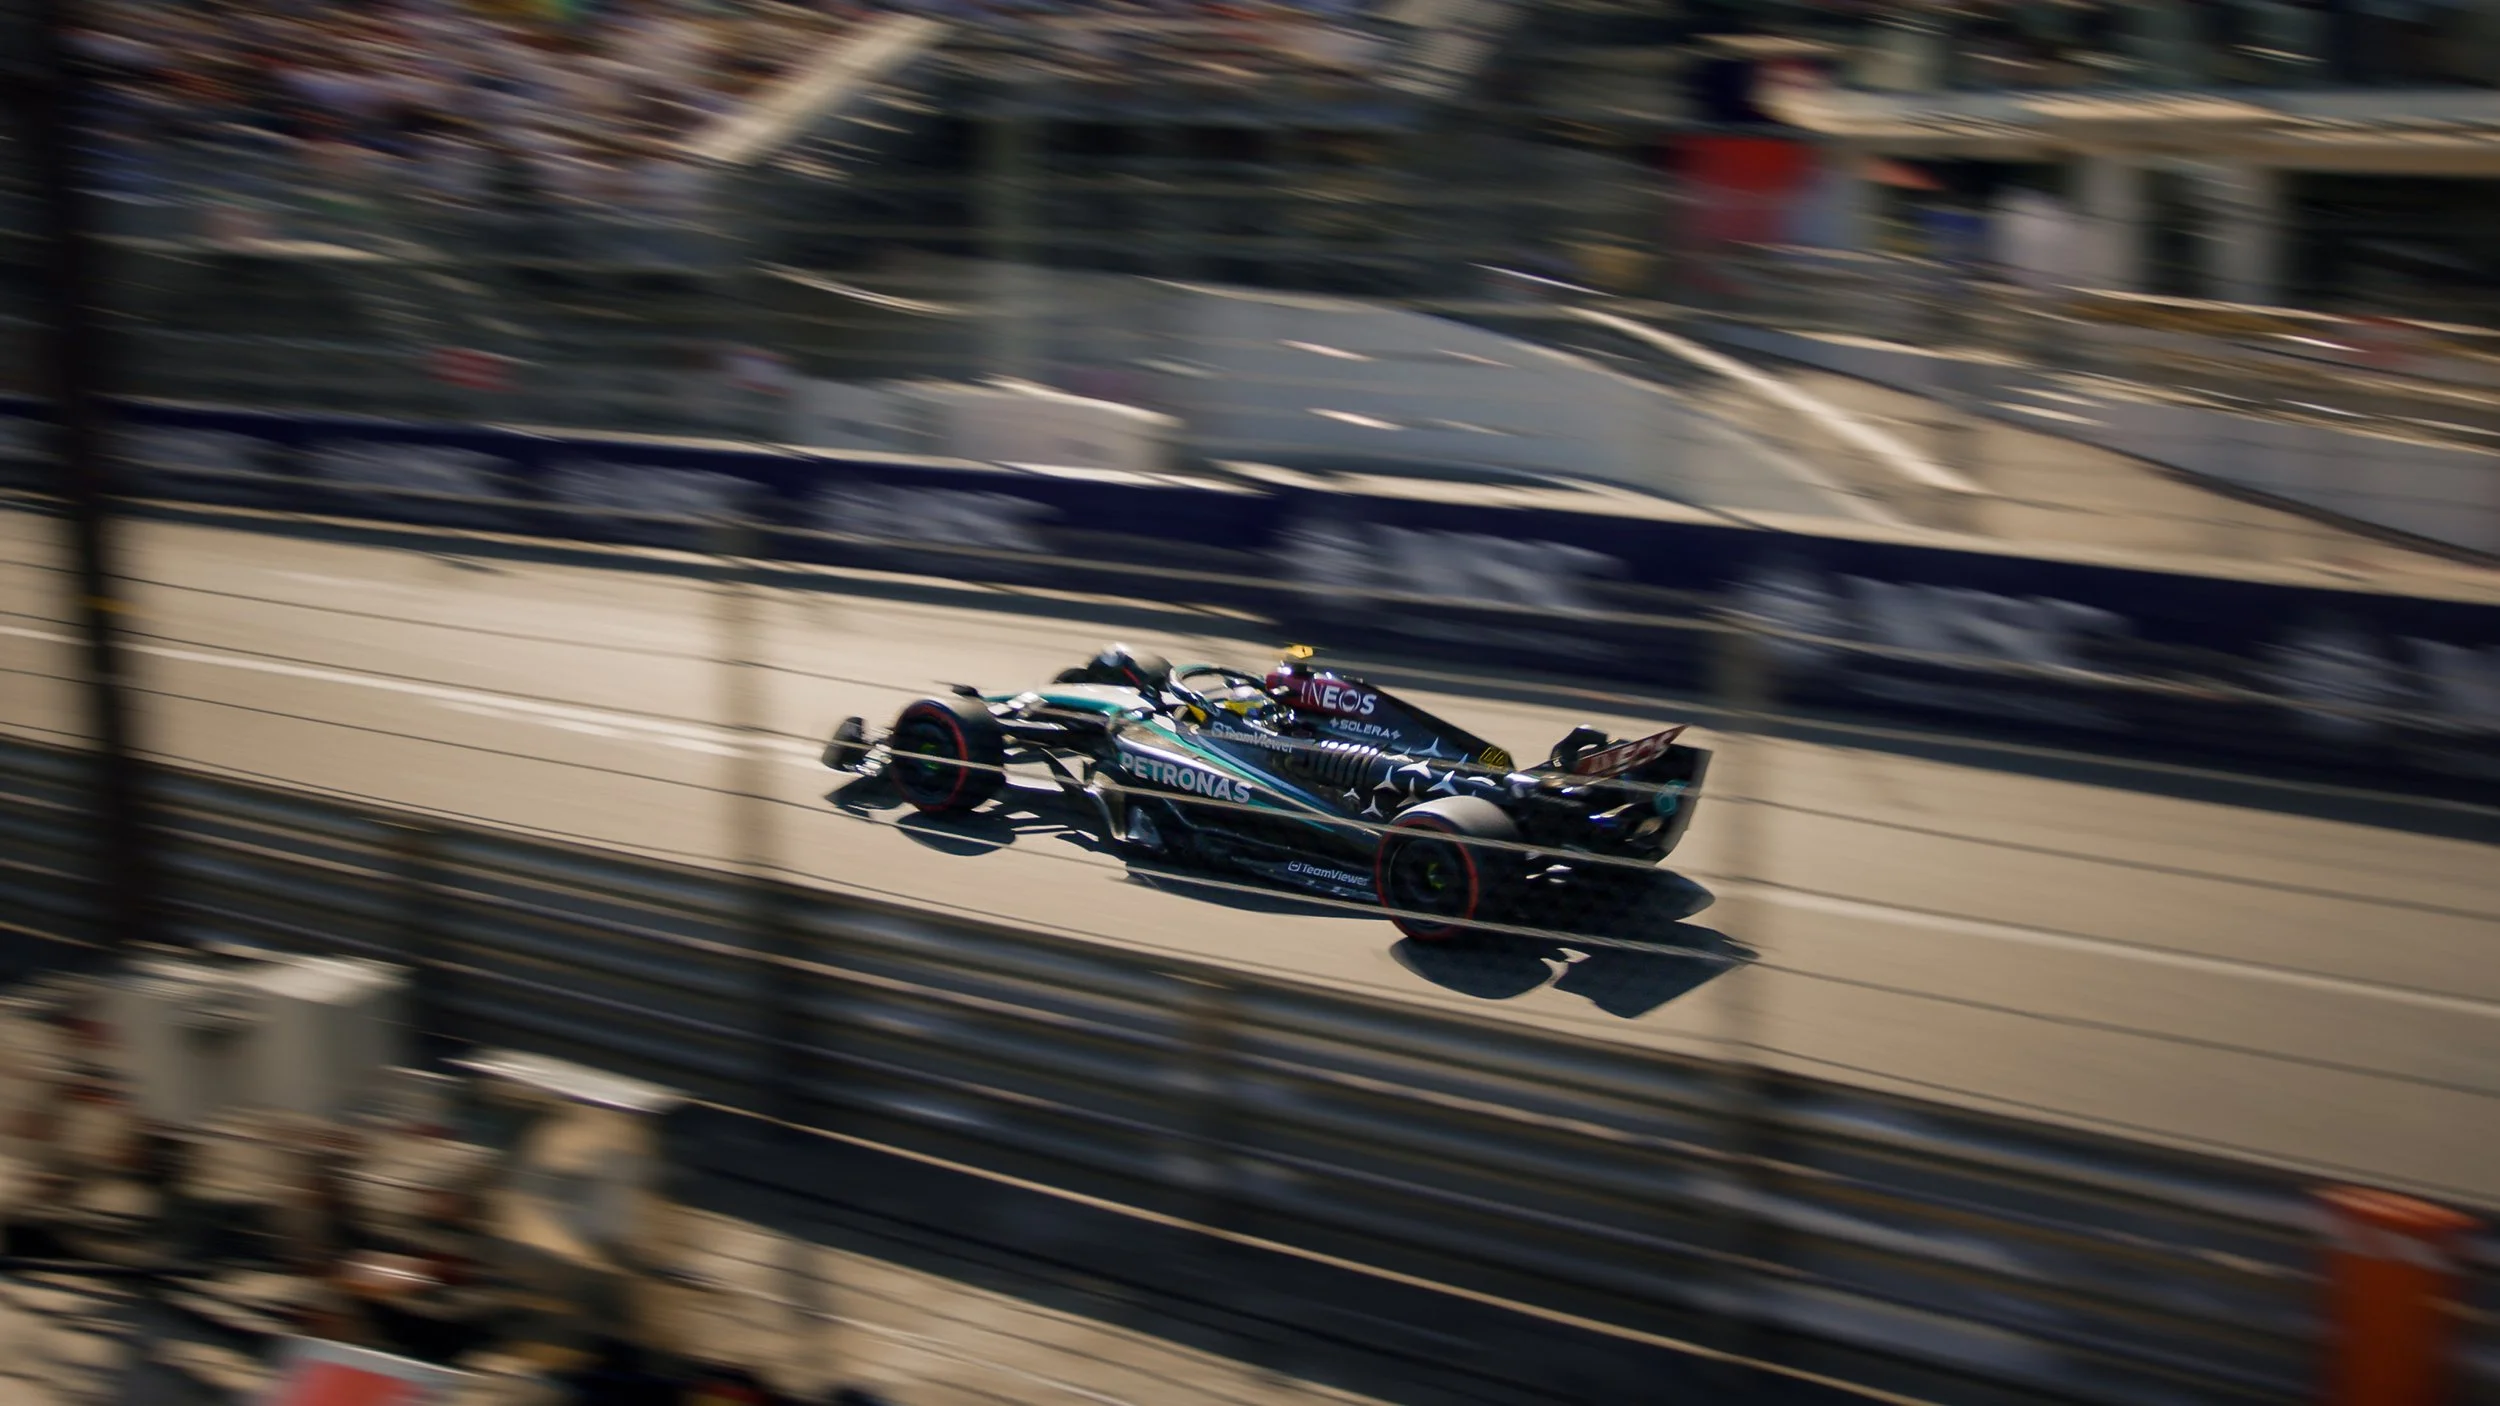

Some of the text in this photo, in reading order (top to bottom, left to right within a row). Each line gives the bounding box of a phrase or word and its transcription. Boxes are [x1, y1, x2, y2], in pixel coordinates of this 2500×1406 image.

[1301, 681, 1377, 715] INEOS
[1340, 719, 1391, 738] SOLERA
[1120, 751, 1253, 804] PETRONAS
[1302, 863, 1369, 887] TeamViewer
